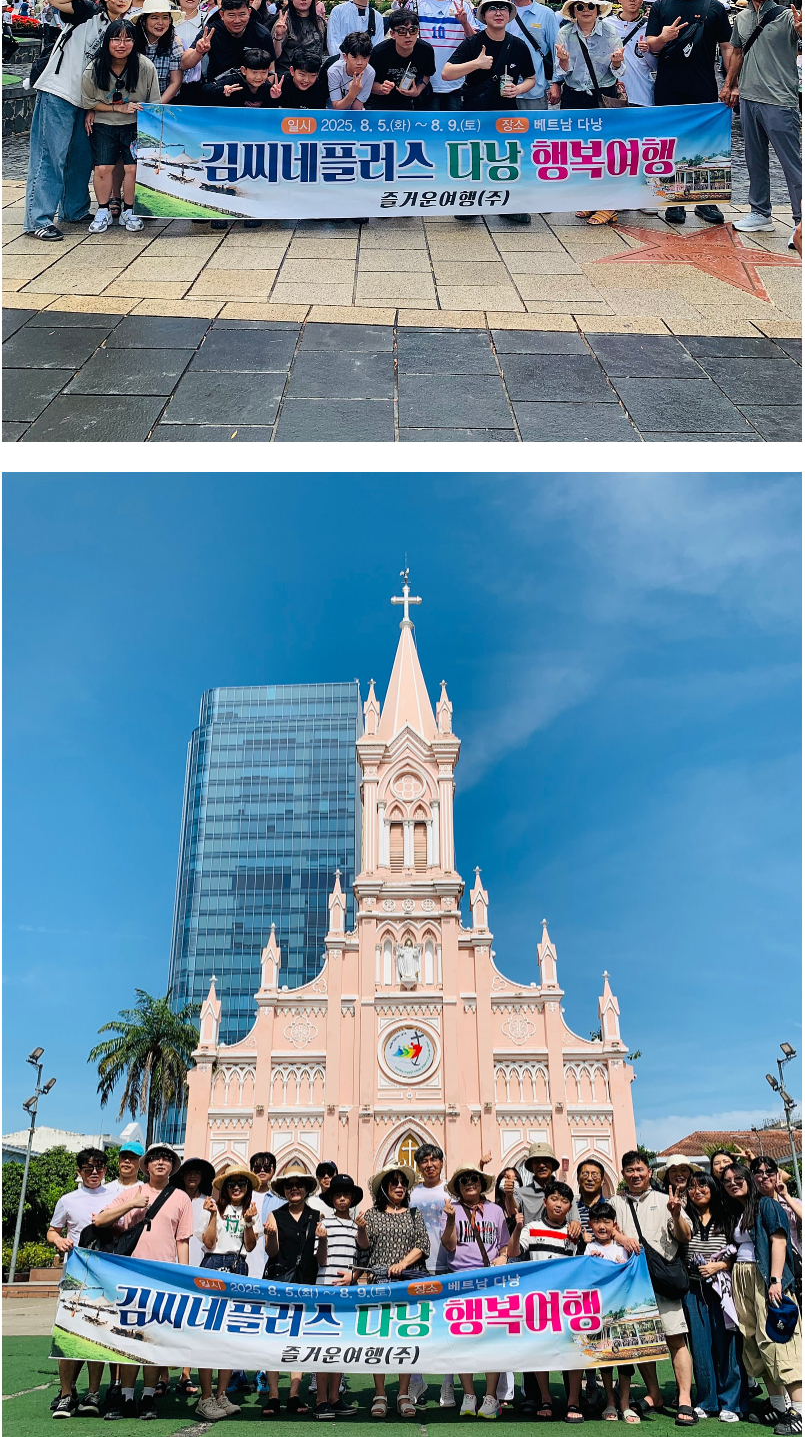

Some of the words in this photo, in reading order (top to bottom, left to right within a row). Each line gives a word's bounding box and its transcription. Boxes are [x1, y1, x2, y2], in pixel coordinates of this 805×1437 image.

[432, 26, 445, 39] 10
[287, 119, 312, 132] 일시
[321, 119, 356, 132] 2025.
[502, 119, 525, 131] 장소
[534, 118, 572, 131] 베트남
[578, 117, 603, 131] 다낭
[201, 141, 435, 183] 김씨네플러스
[447, 141, 522, 181] 다낭
[532, 137, 676, 180] 행복여행
[380, 189, 510, 209] 즐거운여행(주)
[198, 1278, 222, 1291] 일시
[230, 1282, 264, 1295] 2025.
[414, 1283, 438, 1295] 장소
[448, 1279, 488, 1291] 베트남
[494, 1275, 521, 1287] 다낭
[116, 1285, 341, 1337] 김씨네플러스
[356, 1301, 434, 1337] 다낭
[444, 1289, 602, 1335] 행복여행
[281, 1345, 420, 1364] 즐거운여행(주)
